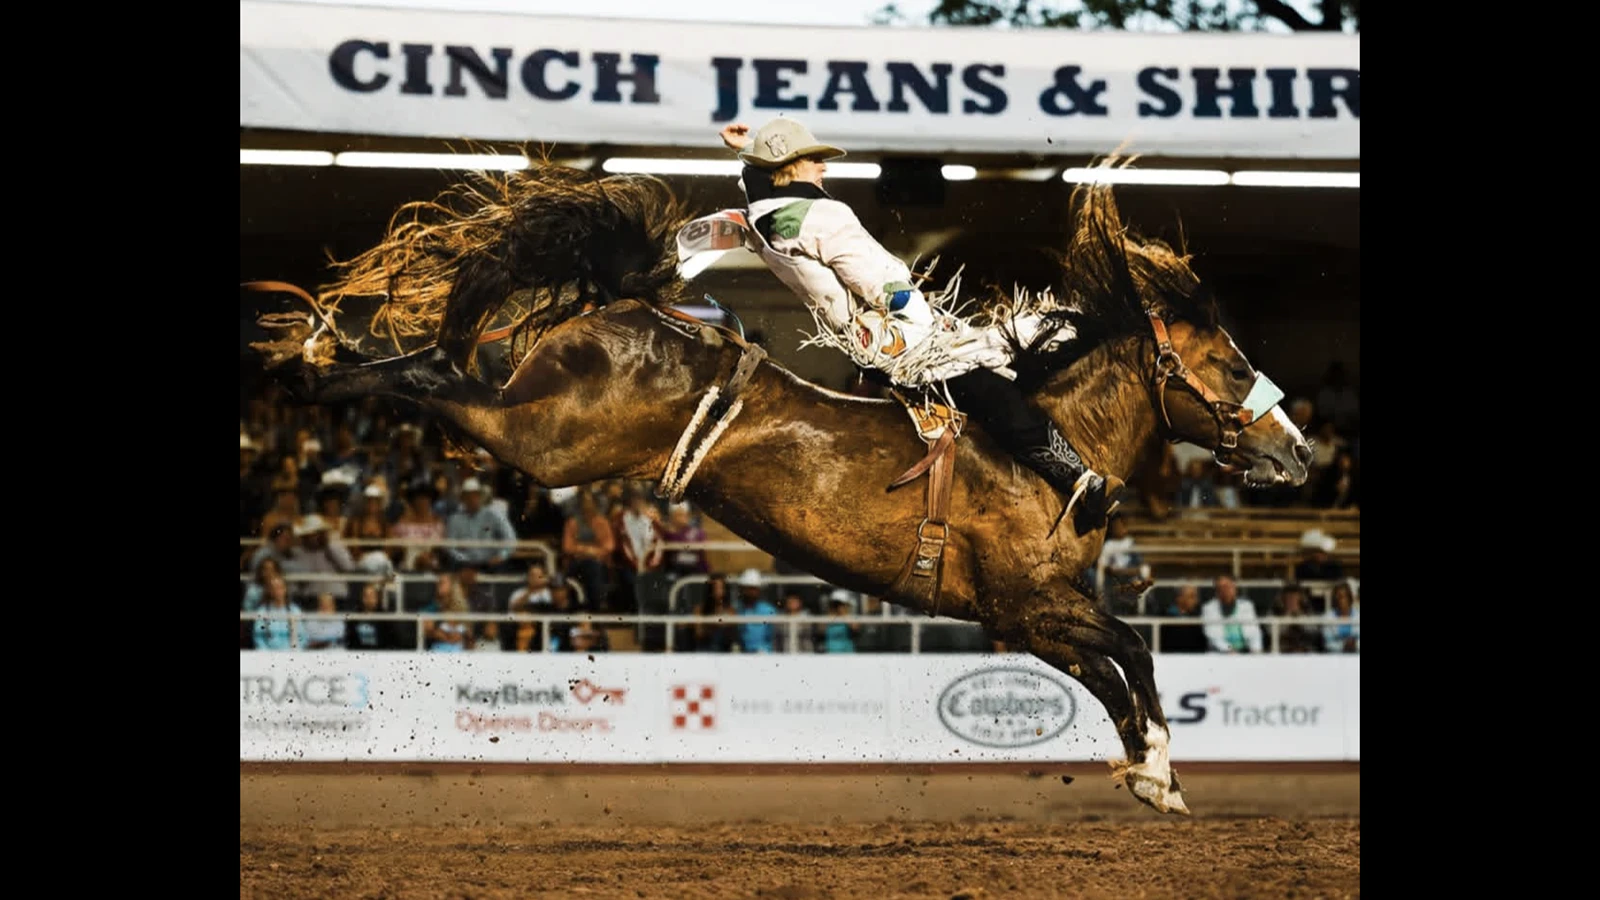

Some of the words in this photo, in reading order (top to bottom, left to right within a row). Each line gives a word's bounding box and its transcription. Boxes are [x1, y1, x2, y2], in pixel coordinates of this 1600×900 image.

[328, 38, 661, 105] CINCH
[711, 56, 1009, 122] JEANS
[1038, 64, 1109, 117] &
[1136, 66, 1360, 119] SHIR
[455, 683, 564, 707] KeyBank
[1220, 700, 1321, 726] Tractor
